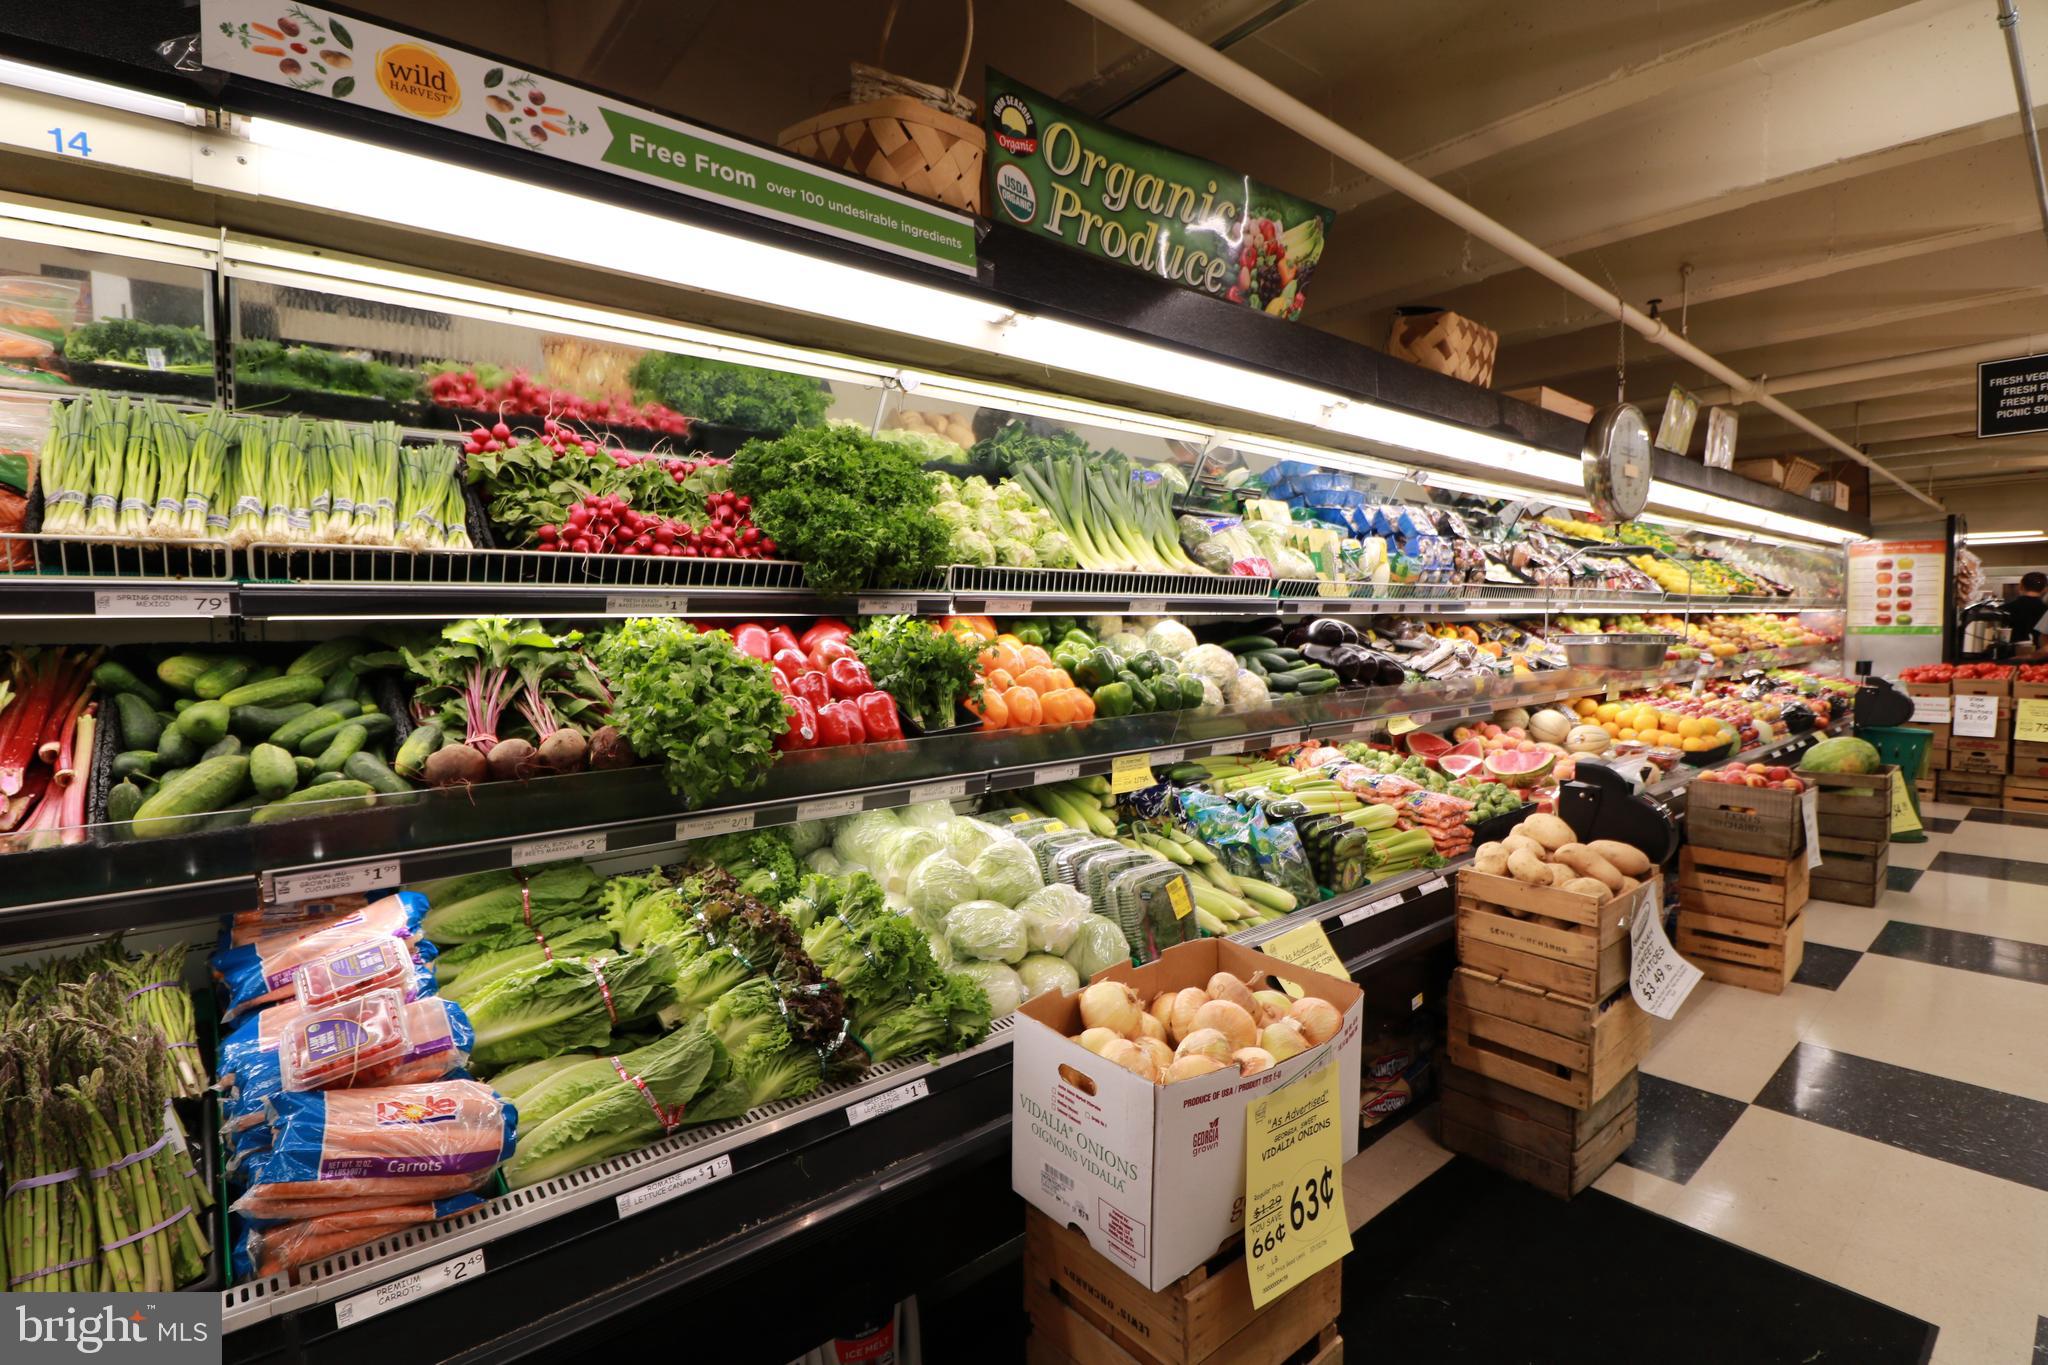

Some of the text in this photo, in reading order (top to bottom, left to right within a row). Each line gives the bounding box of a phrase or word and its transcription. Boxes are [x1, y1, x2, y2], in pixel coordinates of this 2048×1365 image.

[387, 62, 448, 92] wild
[46, 127, 93, 157] 14
[999, 135, 1035, 155] Organic
[1042, 121, 1236, 224] Organic
[629, 133, 963, 250] Free From over 100 undesirable ingredients
[1003, 174, 1029, 198] USDA
[1001, 188, 1033, 213] ORGANIC
[1043, 181, 1227, 294] Produce
[1989, 372, 2048, 387] FRESH VEG
[2003, 384, 2037, 396] FRESH
[1996, 407, 2031, 419] PICNIC
[2000, 396, 2034, 408] FRESH
[1183, 1092, 1212, 1108] PRODUCE
[1212, 1091, 1221, 1100] OF
[1221, 1087, 1233, 1098] USA
[1300, 1114, 1318, 1131] SWEET
[1031, 1122, 1078, 1163] OIGNONS
[1192, 1127, 1219, 1148] GEORGIA
[1192, 1141, 1219, 1157] grown
[1261, 1118, 1332, 1162] VIDALIA ONIONS
[328, 1161, 340, 1169] NET
[387, 1159, 443, 1173] Carrots
[1076, 1132, 1138, 1181] ONIONS
[634, 1176, 697, 1206] LETTUCE CANADA
[647, 1173, 682, 1192] ROMAINE
[1290, 1165, 1334, 1231] 63¢
[1251, 1212, 1283, 1235] YOU SAVE
[1252, 1223, 1287, 1258] 66¢
[376, 1275, 421, 1298] PREMIUM
[378, 1283, 422, 1306] CARROTS
[864, 1336, 889, 1355] MELT
